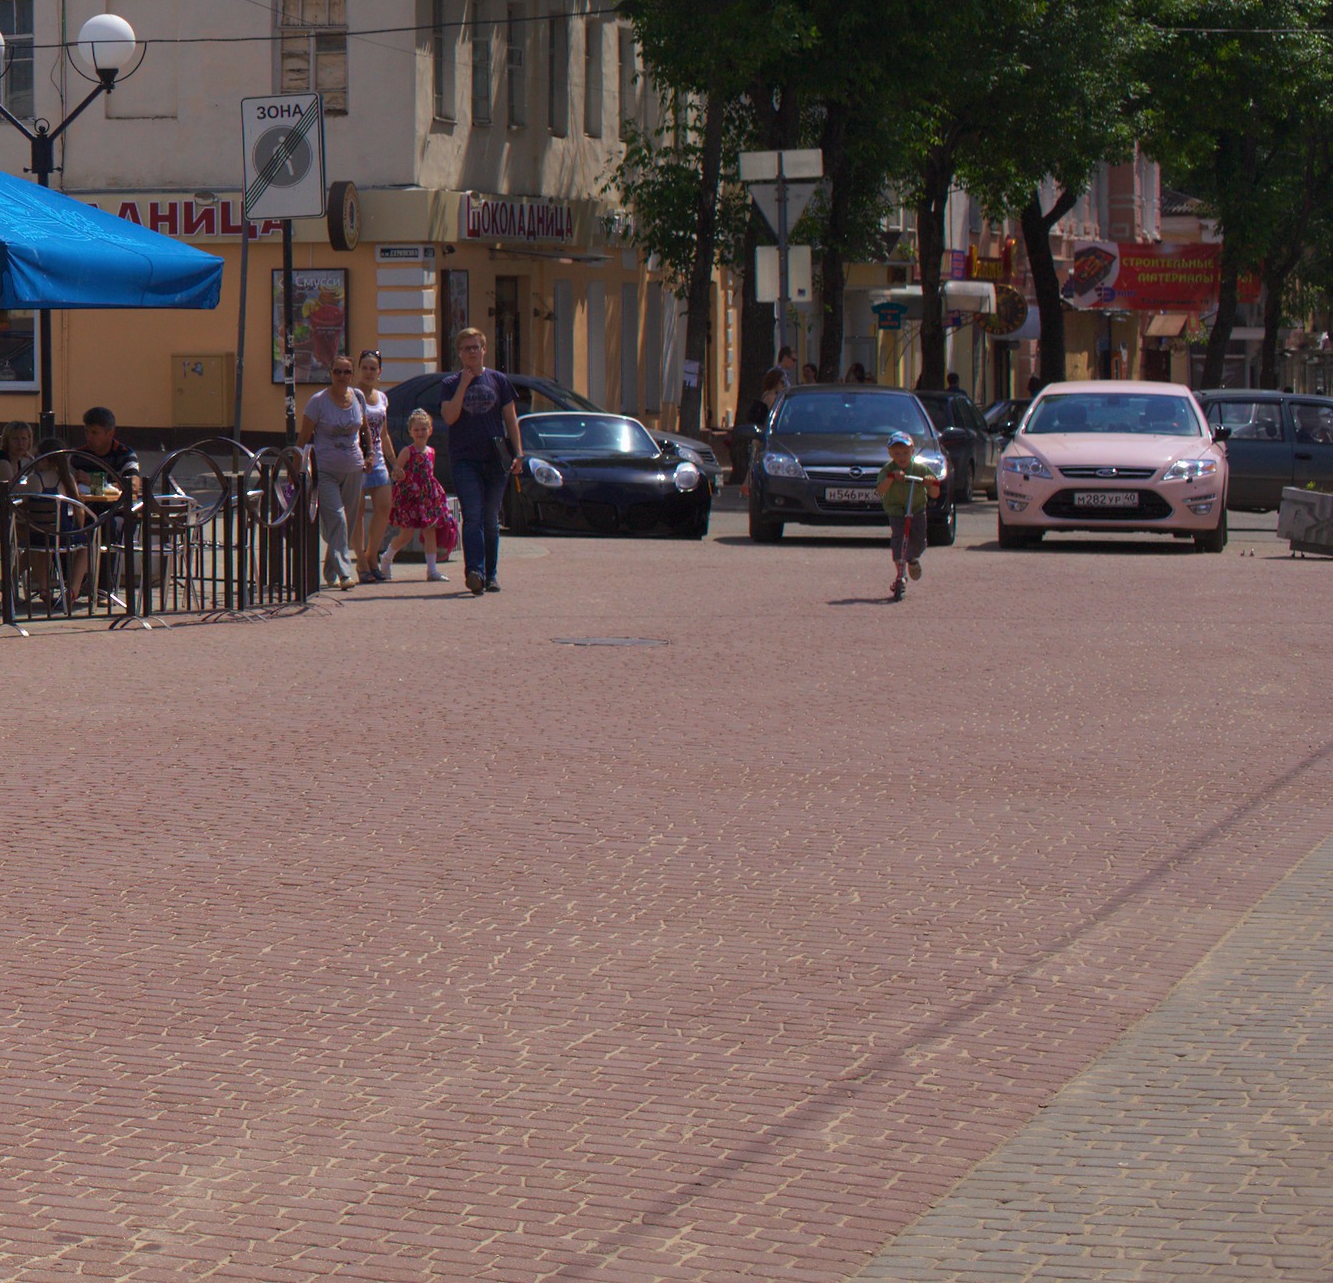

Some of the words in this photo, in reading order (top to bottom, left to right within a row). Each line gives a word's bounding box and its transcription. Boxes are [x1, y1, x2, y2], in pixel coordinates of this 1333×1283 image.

[257, 103, 304, 119] ЗОНА
[467, 195, 573, 241] ШОКОЛАДНИЦА
[1122, 257, 1214, 269] СТРОИТЕЛЬНЫЕ
[1137, 272, 1213, 284] МАТЕРИАЛЫ
[1077, 494, 1121, 504] М282УР
[1124, 493, 1135, 501] 40
